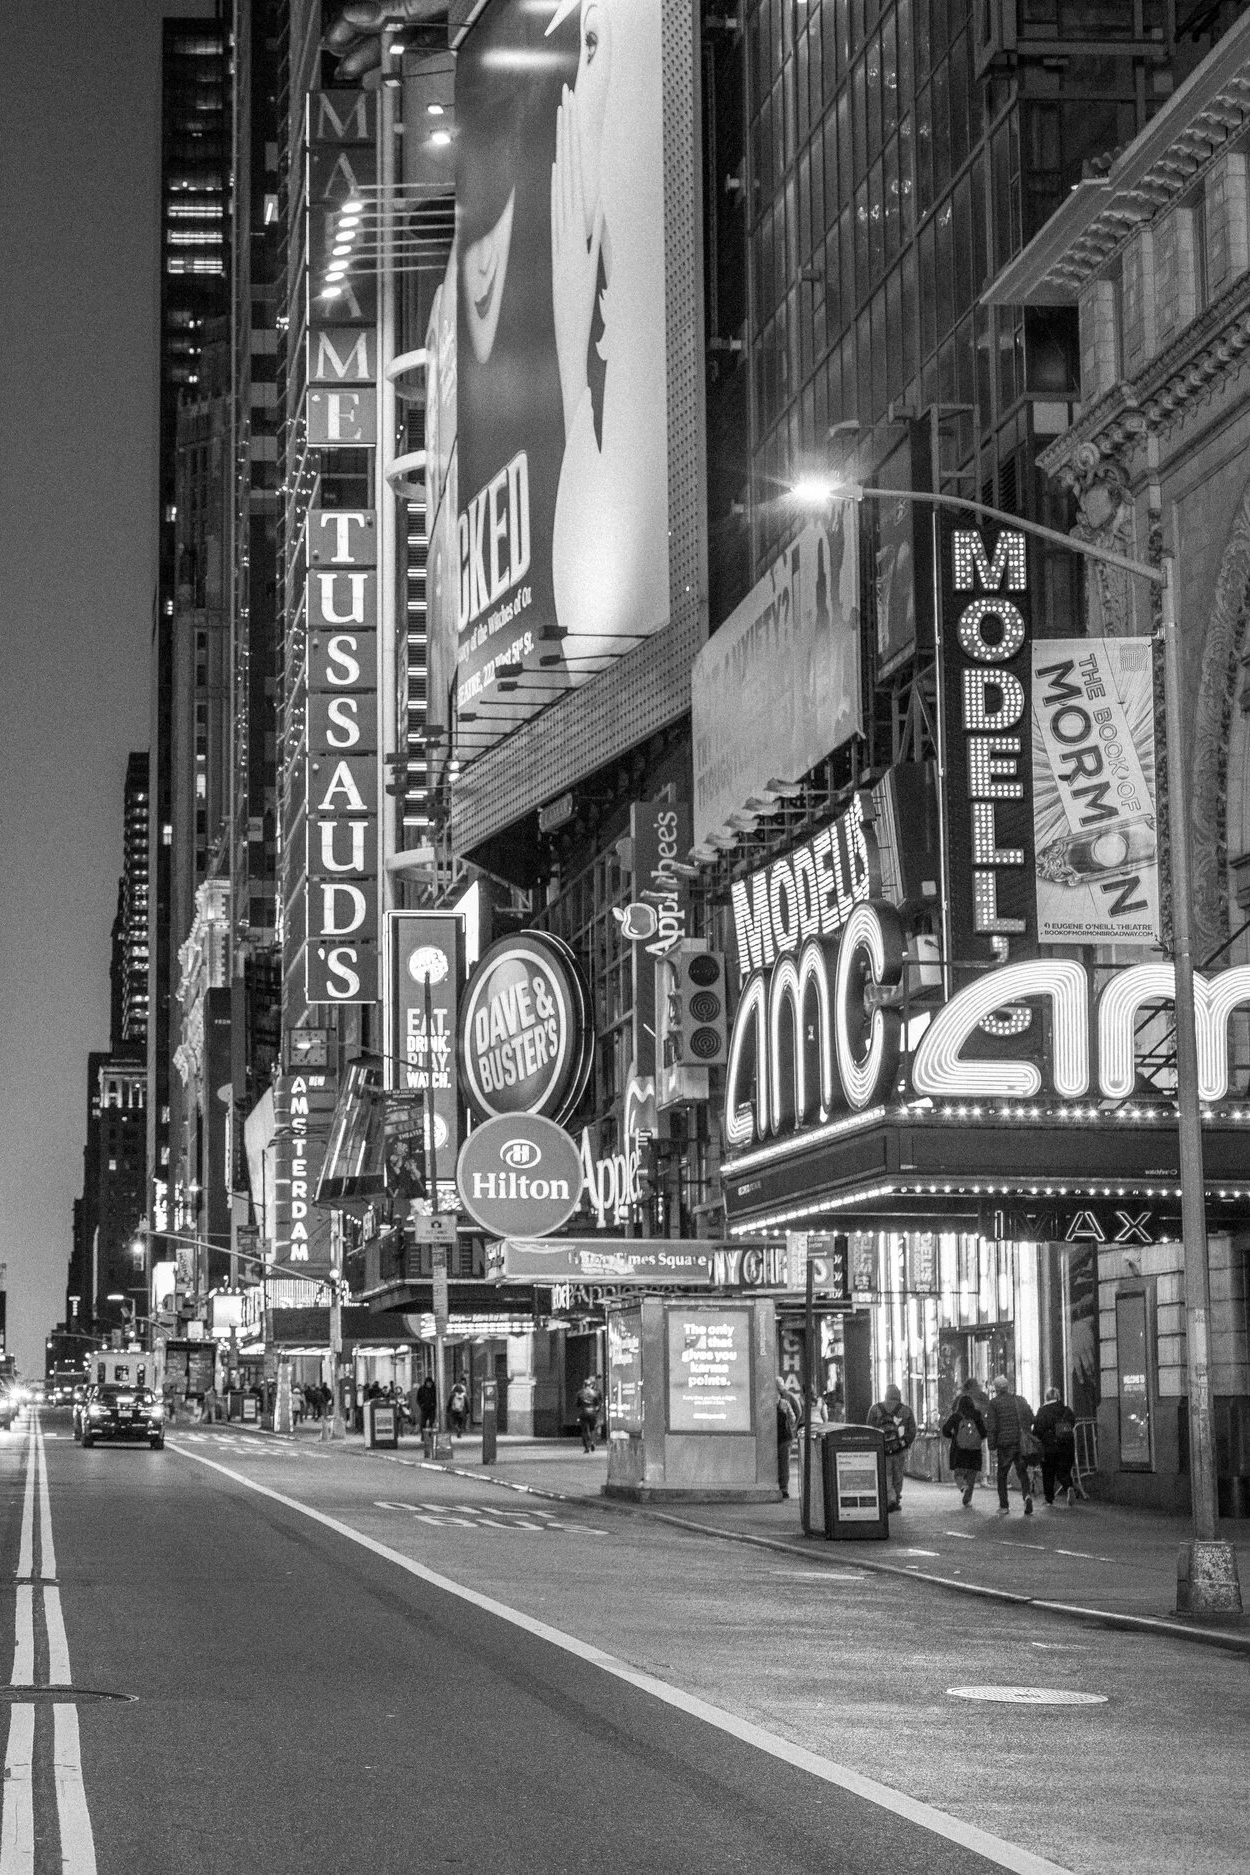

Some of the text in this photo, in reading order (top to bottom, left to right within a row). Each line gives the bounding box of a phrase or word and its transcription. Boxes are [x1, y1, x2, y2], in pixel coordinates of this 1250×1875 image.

[316, 93, 369, 998] MAME TUSSAUD'S
[1079, 652, 1142, 812] THE BOOK OF
[1051, 923, 1083, 931] EUGENE
[1116, 923, 1153, 931] THEATRE
[475, 976, 555, 1056] DAVE &
[478, 1016, 559, 1094] BUSTER'S
[407, 1072, 451, 1088] WATCH.
[290, 1076, 309, 1262] AMSTERDAM
[473, 1171, 570, 1200] Hilton
[993, 1210, 1153, 1243] IMAX
[657, 1251, 707, 1270] Square
[683, 1323, 735, 1337] The only
[689, 1361, 730, 1374] karma
[715, 1351, 738, 1363] you
[687, 1374, 732, 1388] points.
[413, 1514, 610, 1535] BUS
